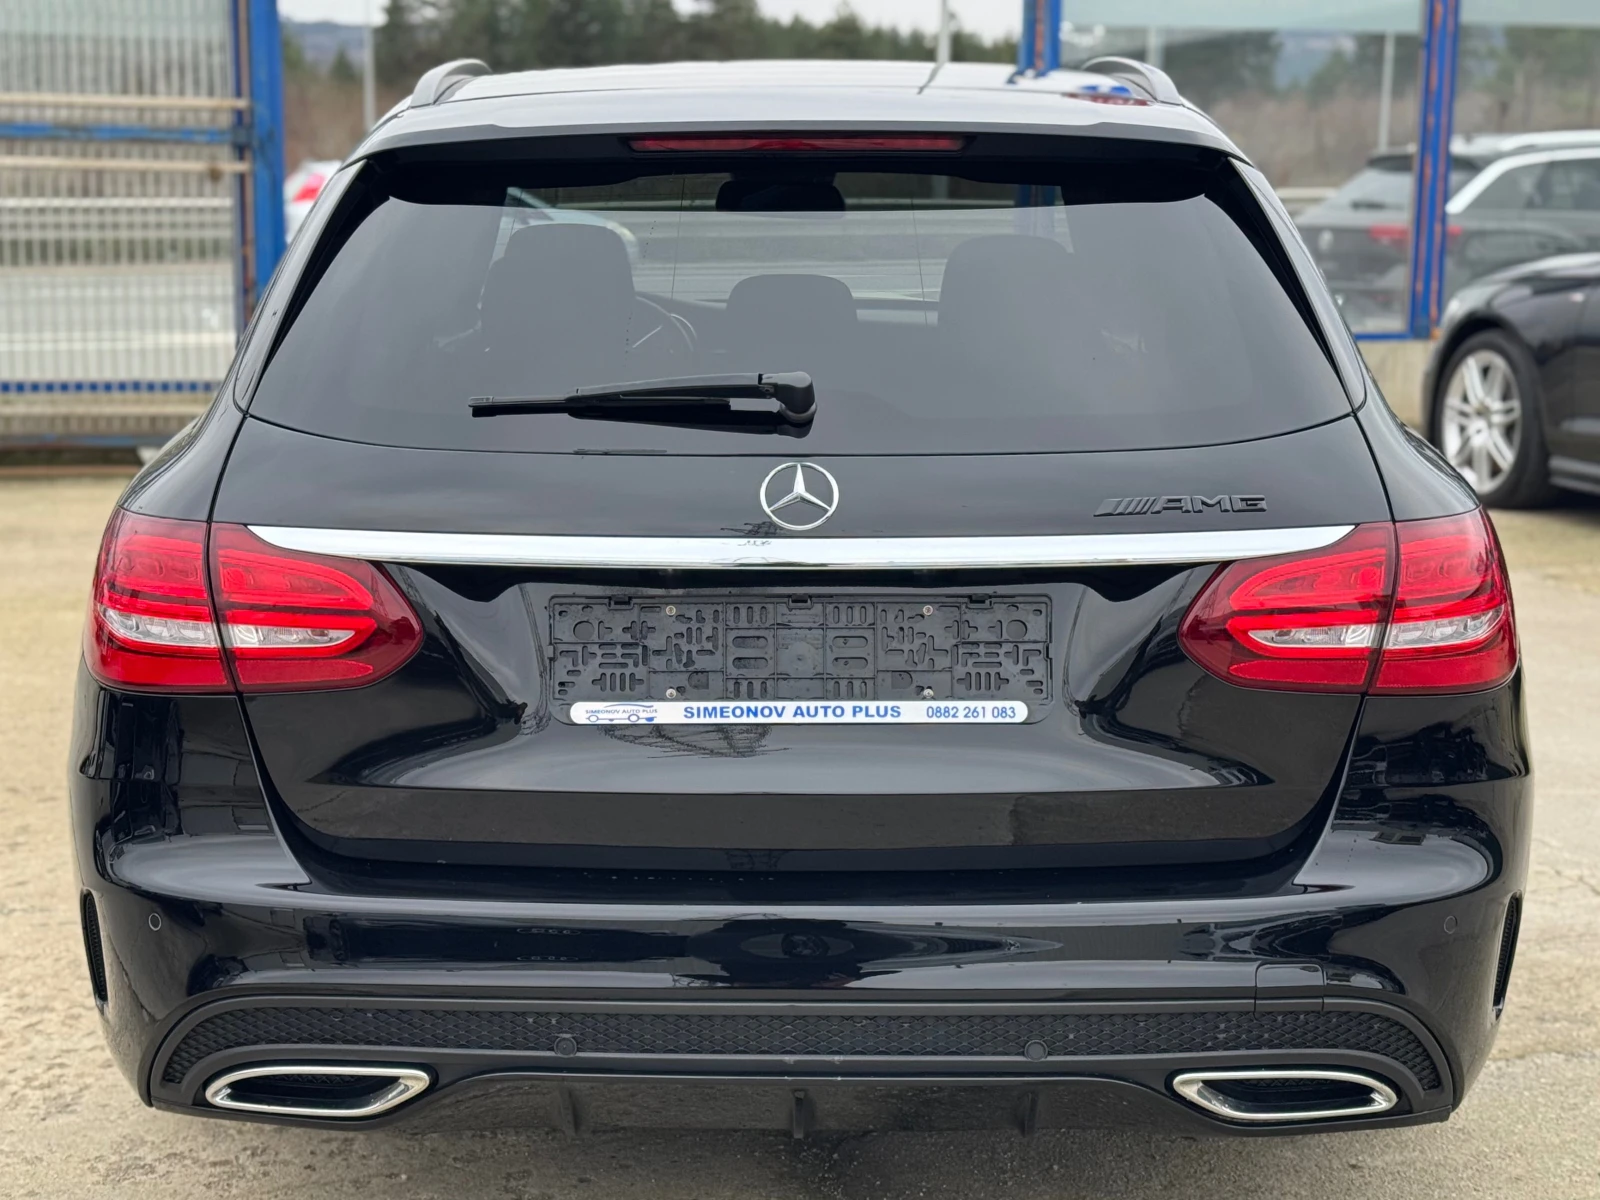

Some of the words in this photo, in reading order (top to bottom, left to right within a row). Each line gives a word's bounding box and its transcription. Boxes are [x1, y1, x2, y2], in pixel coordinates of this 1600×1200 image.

[683, 705, 786, 719] SIMEONOV
[792, 705, 845, 719] AUTO
[851, 705, 902, 719] PLUS
[926, 706, 959, 719] 0882
[963, 706, 986, 719] 261
[991, 706, 1016, 719] 083
